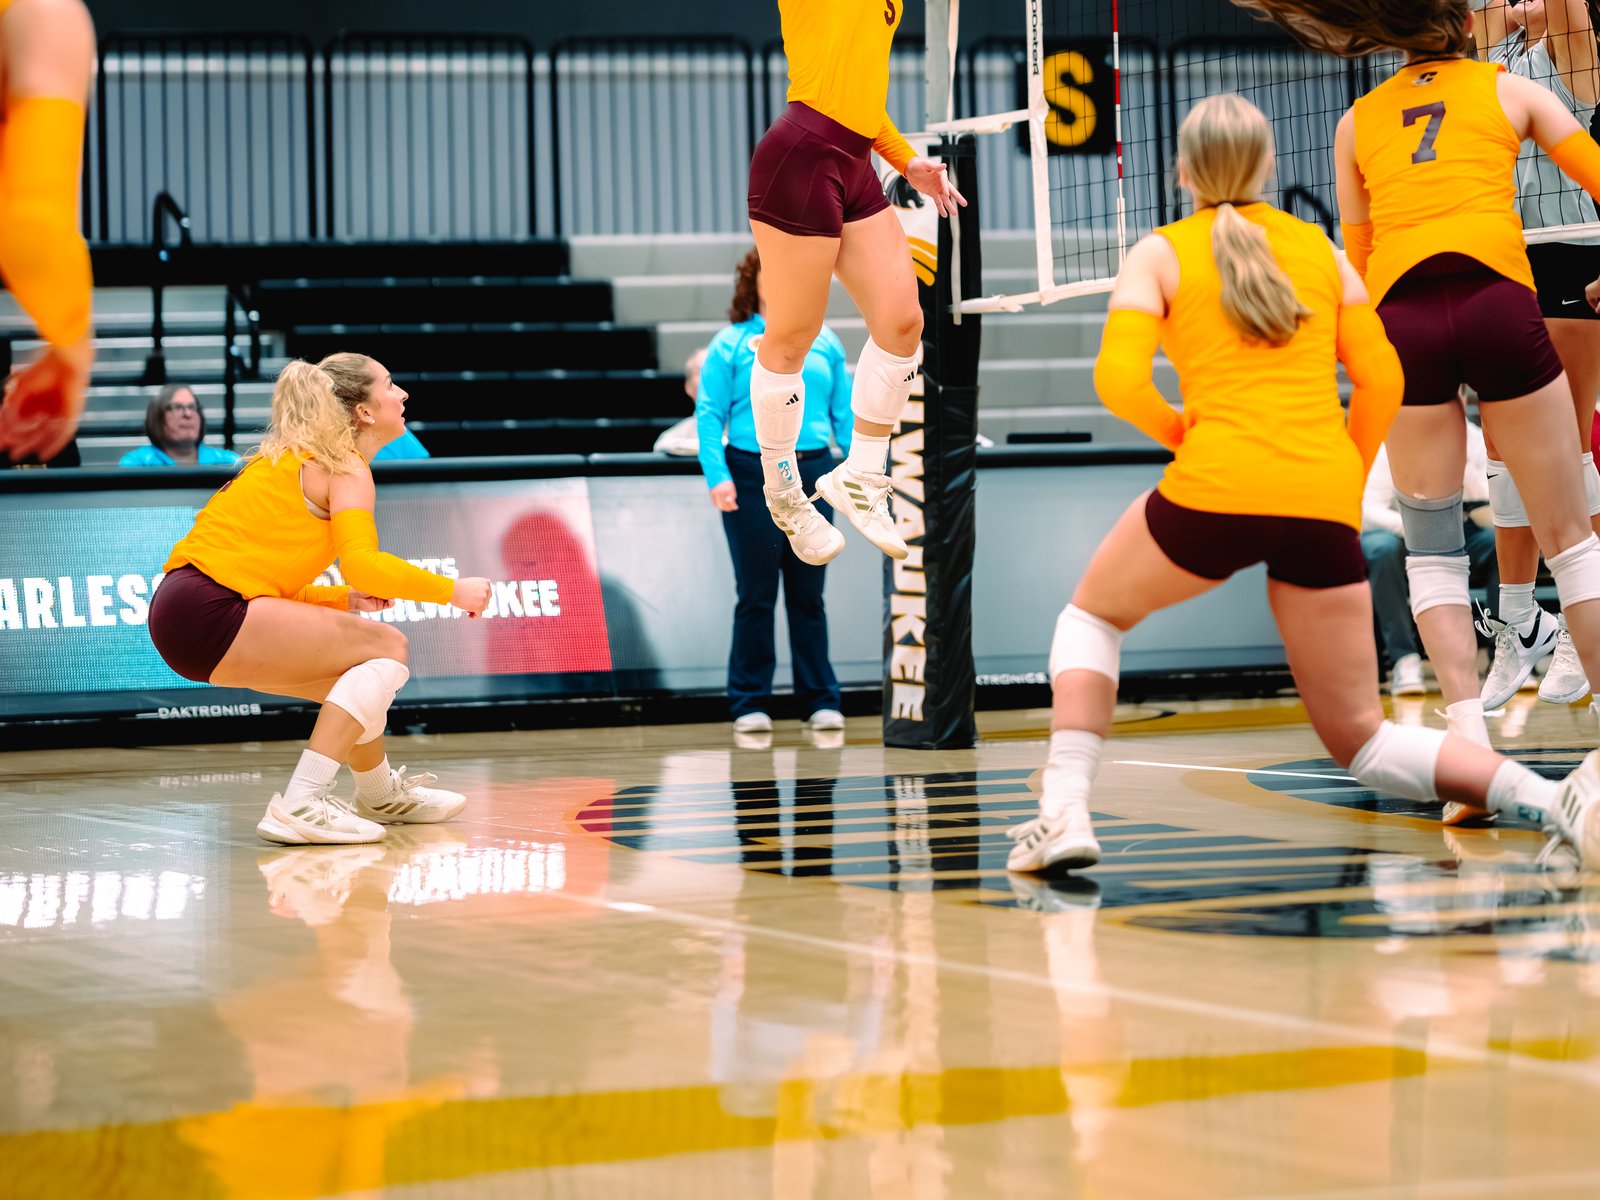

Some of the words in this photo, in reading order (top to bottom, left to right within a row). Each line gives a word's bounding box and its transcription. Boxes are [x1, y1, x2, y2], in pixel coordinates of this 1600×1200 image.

[1043, 50, 1096, 146] S
[1402, 101, 1446, 165] 7
[890, 340, 927, 721] LWAUKEE
[0, 572, 166, 630] ARLES
[158, 703, 262, 719] DAKTRONICS
